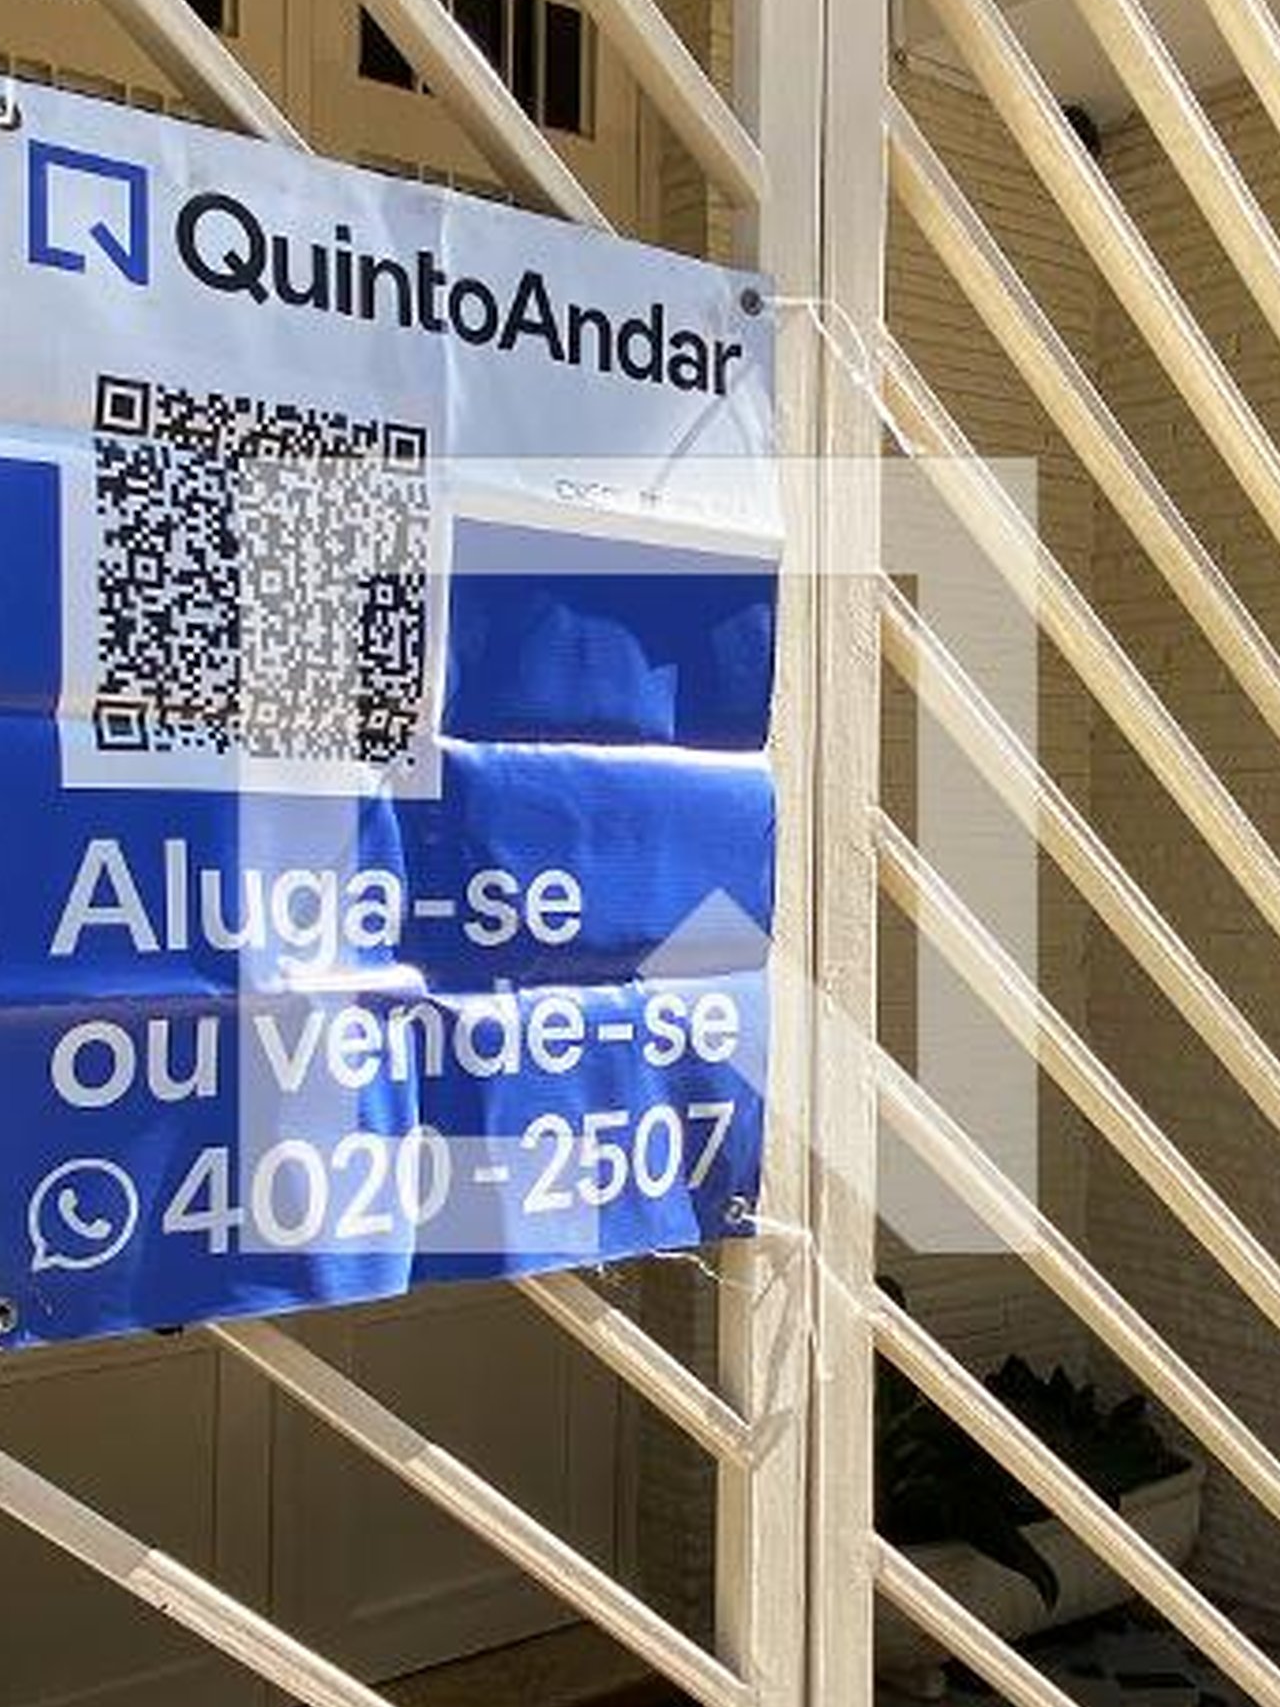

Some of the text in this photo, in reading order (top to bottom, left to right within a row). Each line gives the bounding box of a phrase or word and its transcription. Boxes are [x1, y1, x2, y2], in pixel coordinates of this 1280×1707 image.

[175, 192, 742, 395] QuintoAndar
[50, 837, 582, 978] Aluga-se
[51, 979, 740, 1109] ou vende-se
